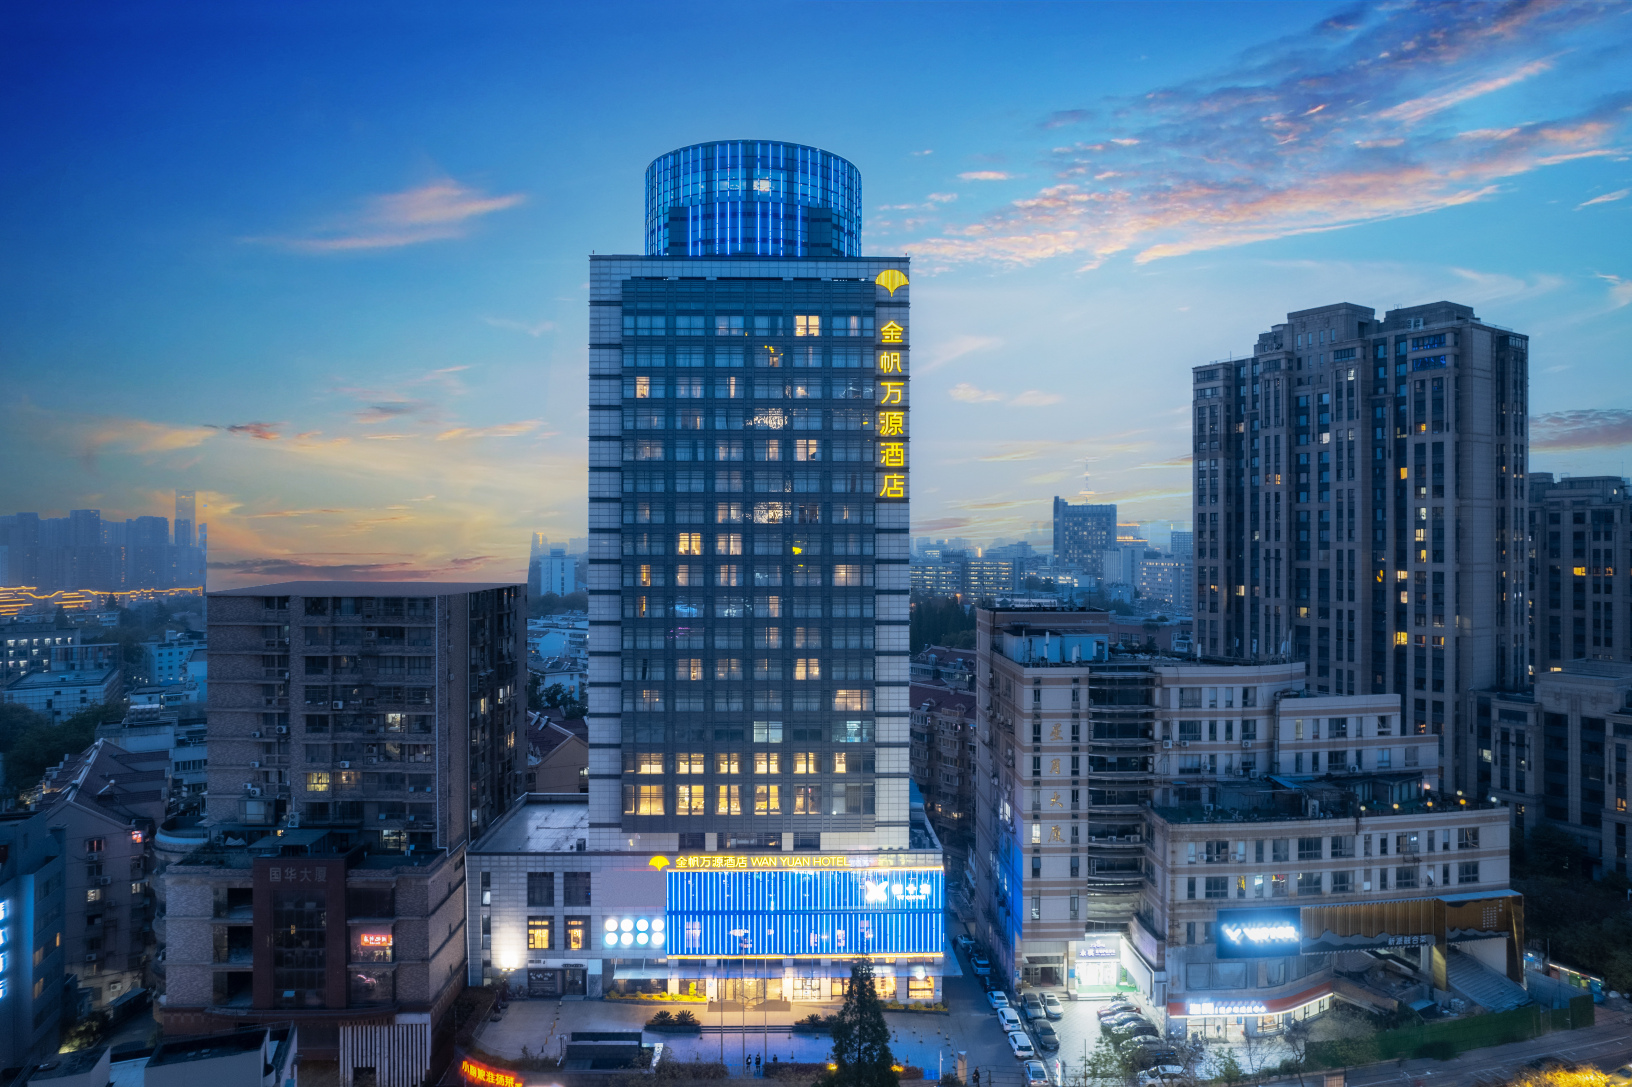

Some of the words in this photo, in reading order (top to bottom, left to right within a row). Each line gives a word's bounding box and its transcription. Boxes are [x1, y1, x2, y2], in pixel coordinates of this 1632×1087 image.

[880, 321, 905, 497] 金帆万源酒店
[675, 855, 748, 868] 金帆万源酒店
[750, 856, 778, 867] WAN
[779, 856, 811, 867] YUAN
[812, 856, 851, 867] HOTEL
[269, 867, 328, 882] 国华大厦
